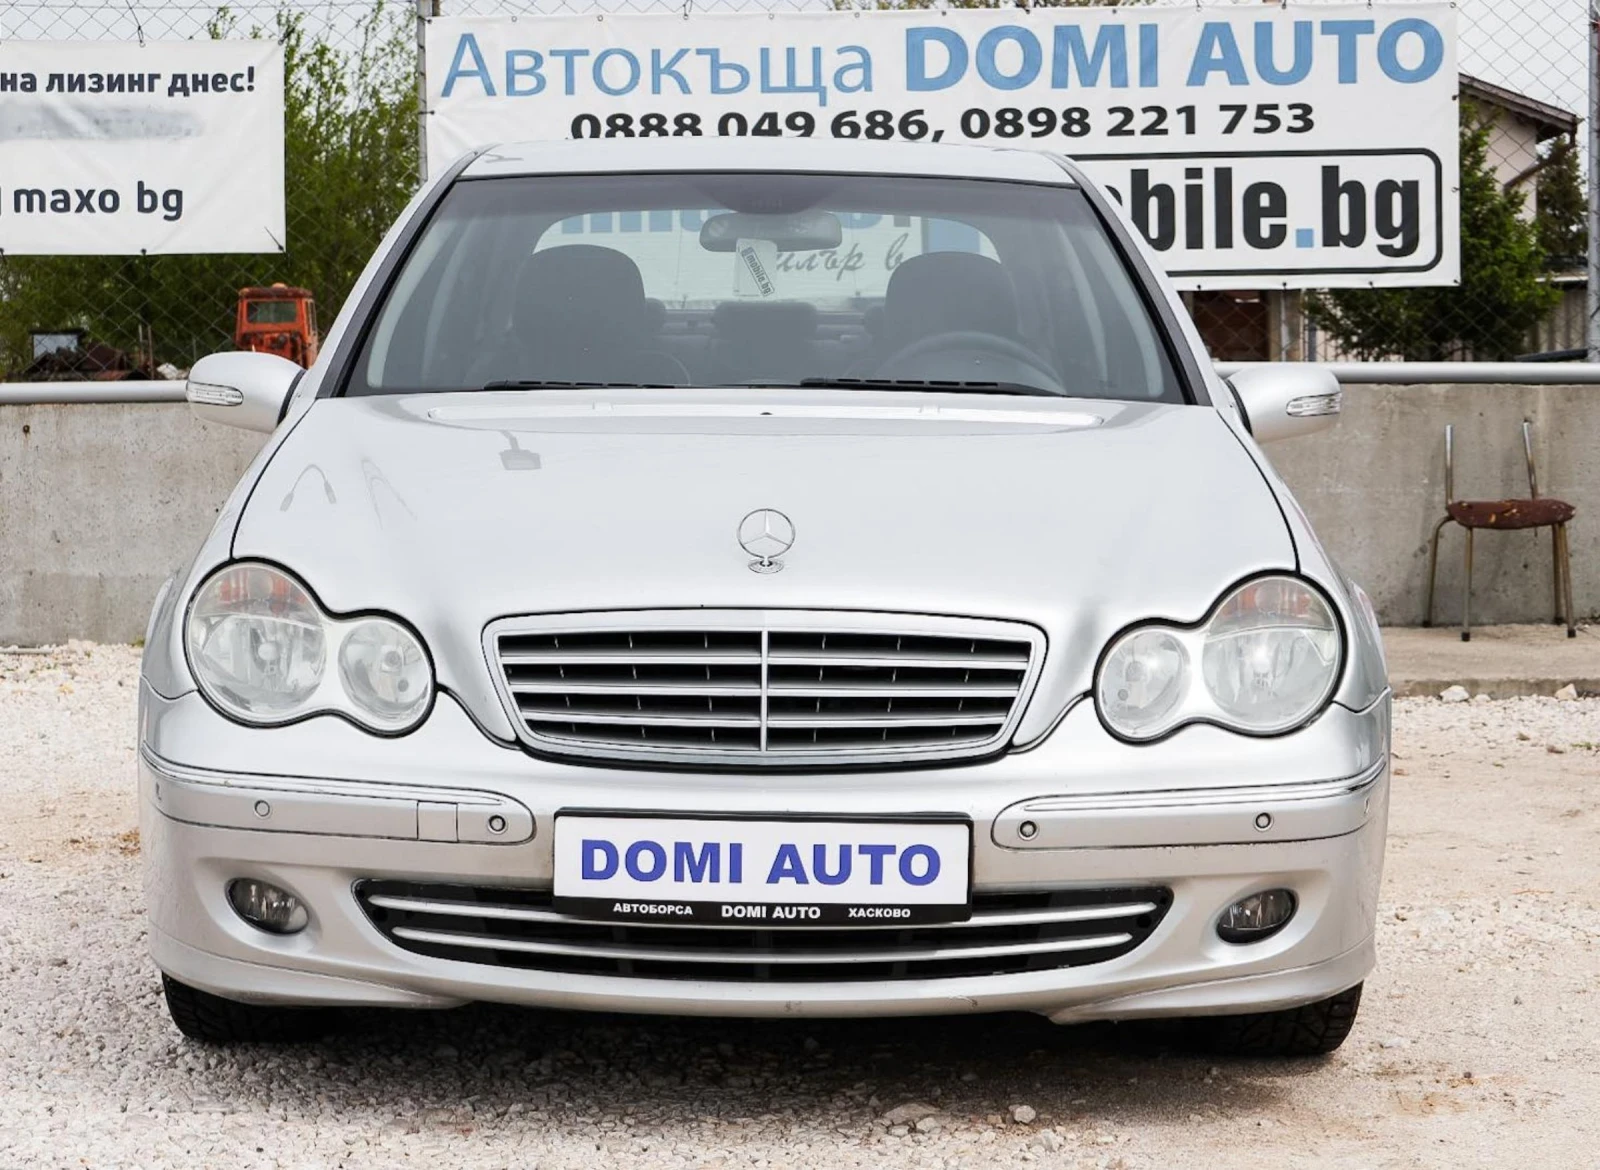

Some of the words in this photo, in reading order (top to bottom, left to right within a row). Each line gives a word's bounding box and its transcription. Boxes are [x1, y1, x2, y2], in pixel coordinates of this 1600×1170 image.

[0, 72, 37, 93] на
[46, 73, 162, 93] лизинг
[167, 66, 255, 98] днес!
[441, 33, 873, 107] Автокъща
[905, 23, 1159, 92] DOMI
[1186, 17, 1444, 88] AUTO
[571, 113, 703, 139] 0888
[717, 111, 816, 137] 049
[830, 109, 945, 143] 686,
[960, 106, 1091, 139] 0898
[1106, 105, 1197, 137] 221
[1219, 102, 1315, 135] 753
[13, 188, 120, 214] maxo
[137, 180, 183, 222] bg
[1104, 165, 1420, 258] bile.bg
[745, 253, 772, 295] mobile.bg
[580, 838, 744, 885] DOMI
[765, 842, 942, 888] AUTO
[613, 902, 693, 915] АВТОБОРСА
[721, 904, 767, 918] DOMI
[771, 906, 821, 919] AUTO
[848, 907, 911, 918] ХАСКОВО
